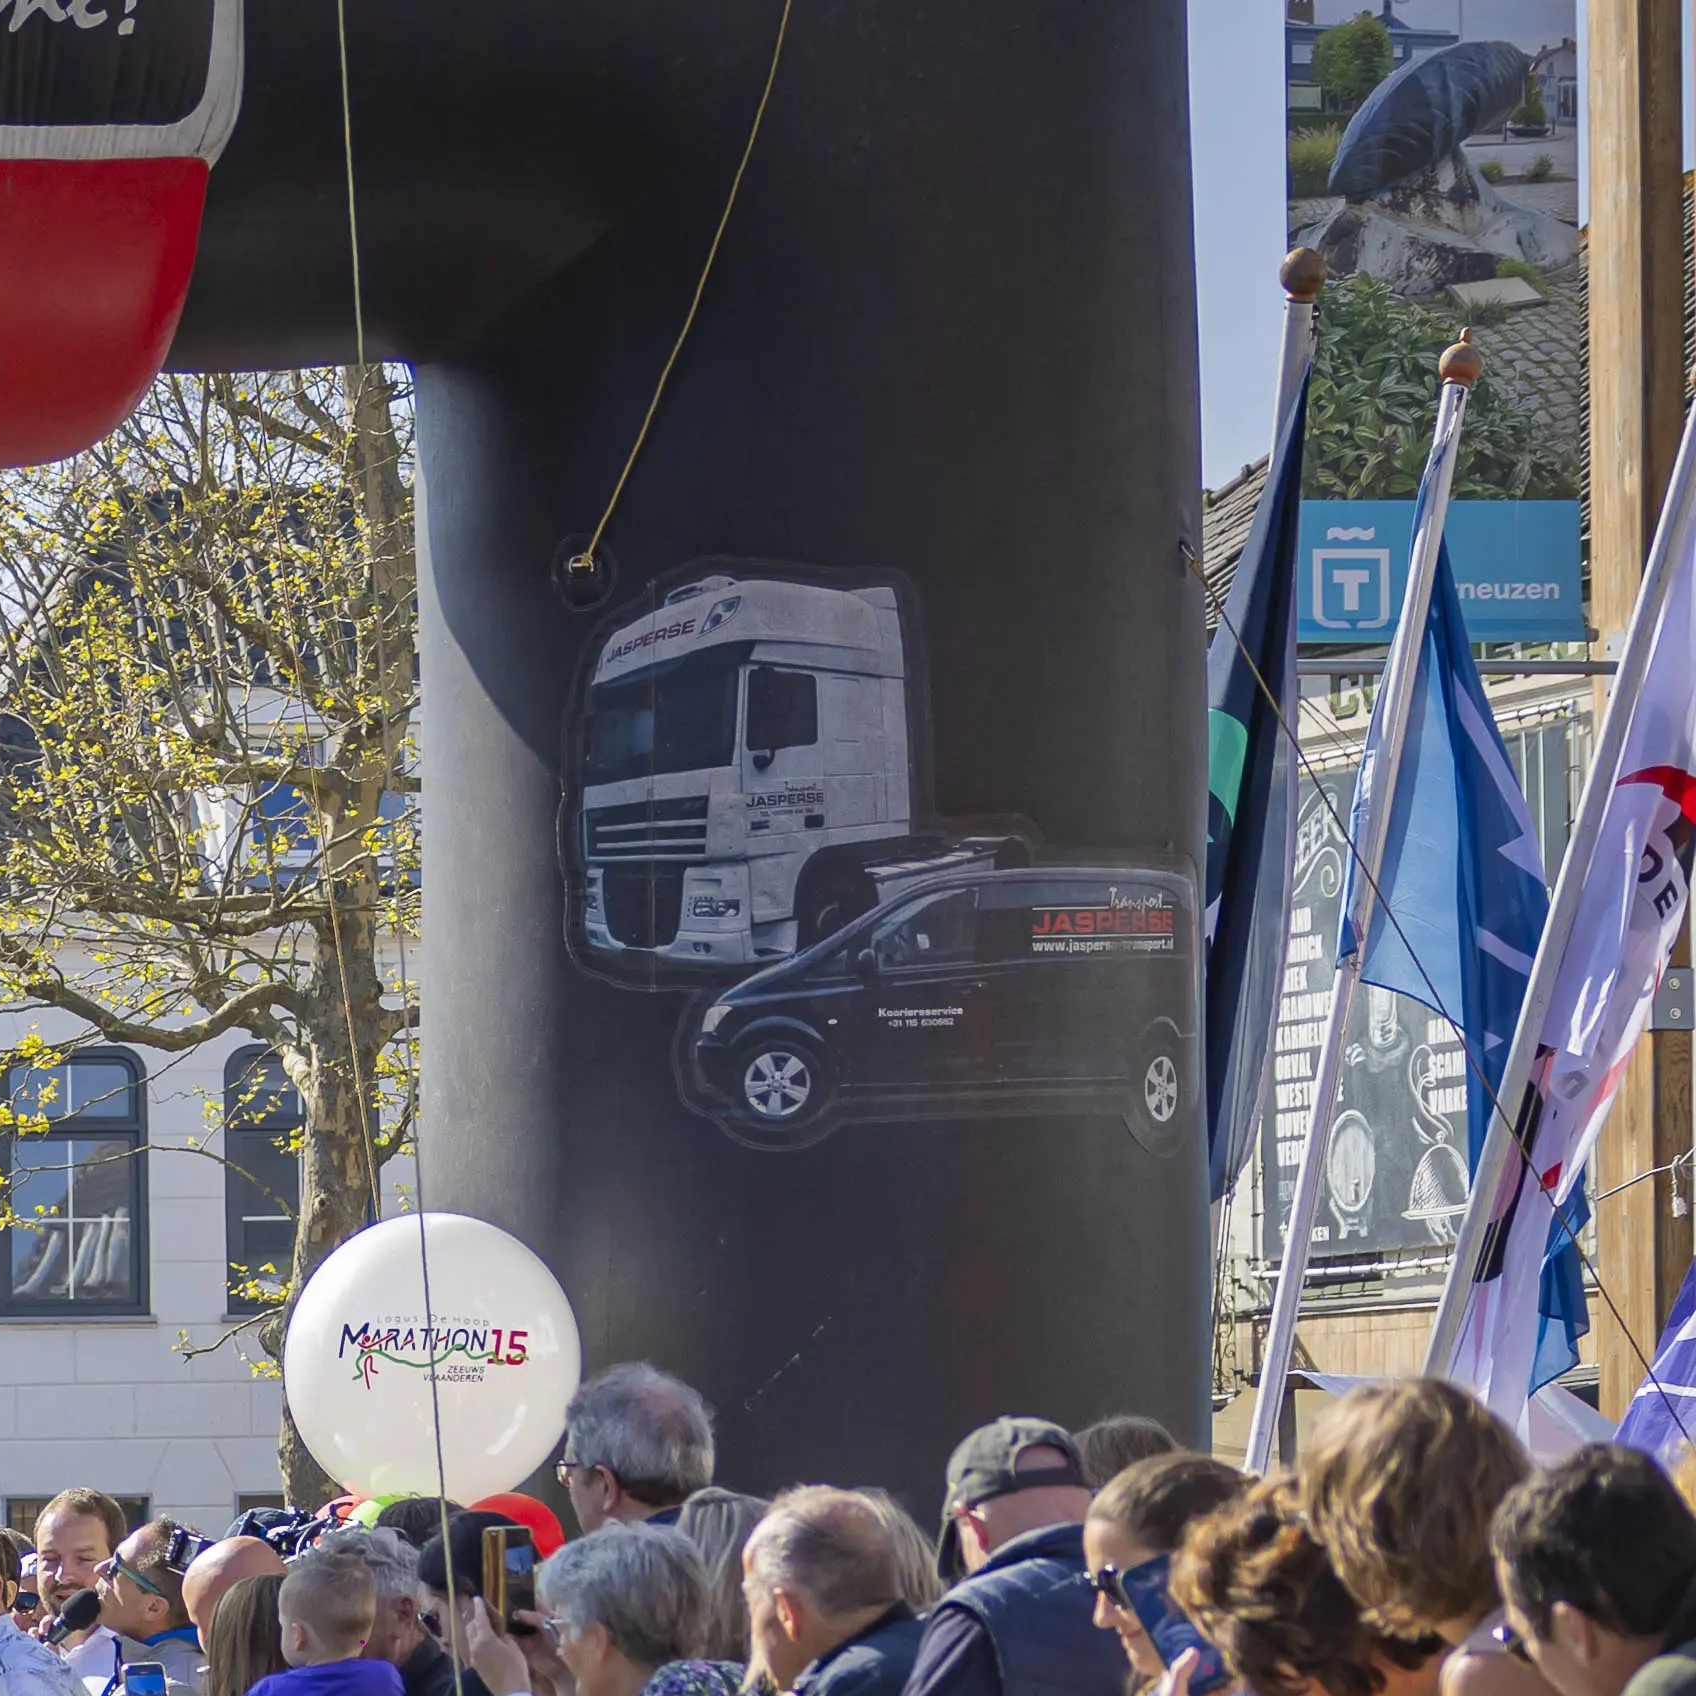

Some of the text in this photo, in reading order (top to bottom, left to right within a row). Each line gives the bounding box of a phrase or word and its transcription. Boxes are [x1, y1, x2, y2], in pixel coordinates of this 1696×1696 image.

[606, 619, 696, 663] JASPERSE
[746, 792, 824, 808] JASPERSE
[1032, 911, 1174, 934] JASPERSE
[338, 1322, 529, 1366] MARATHON 15
[423, 1374, 484, 1382] VLAANDEREN
[447, 1365, 486, 1374] ZEEUWS
